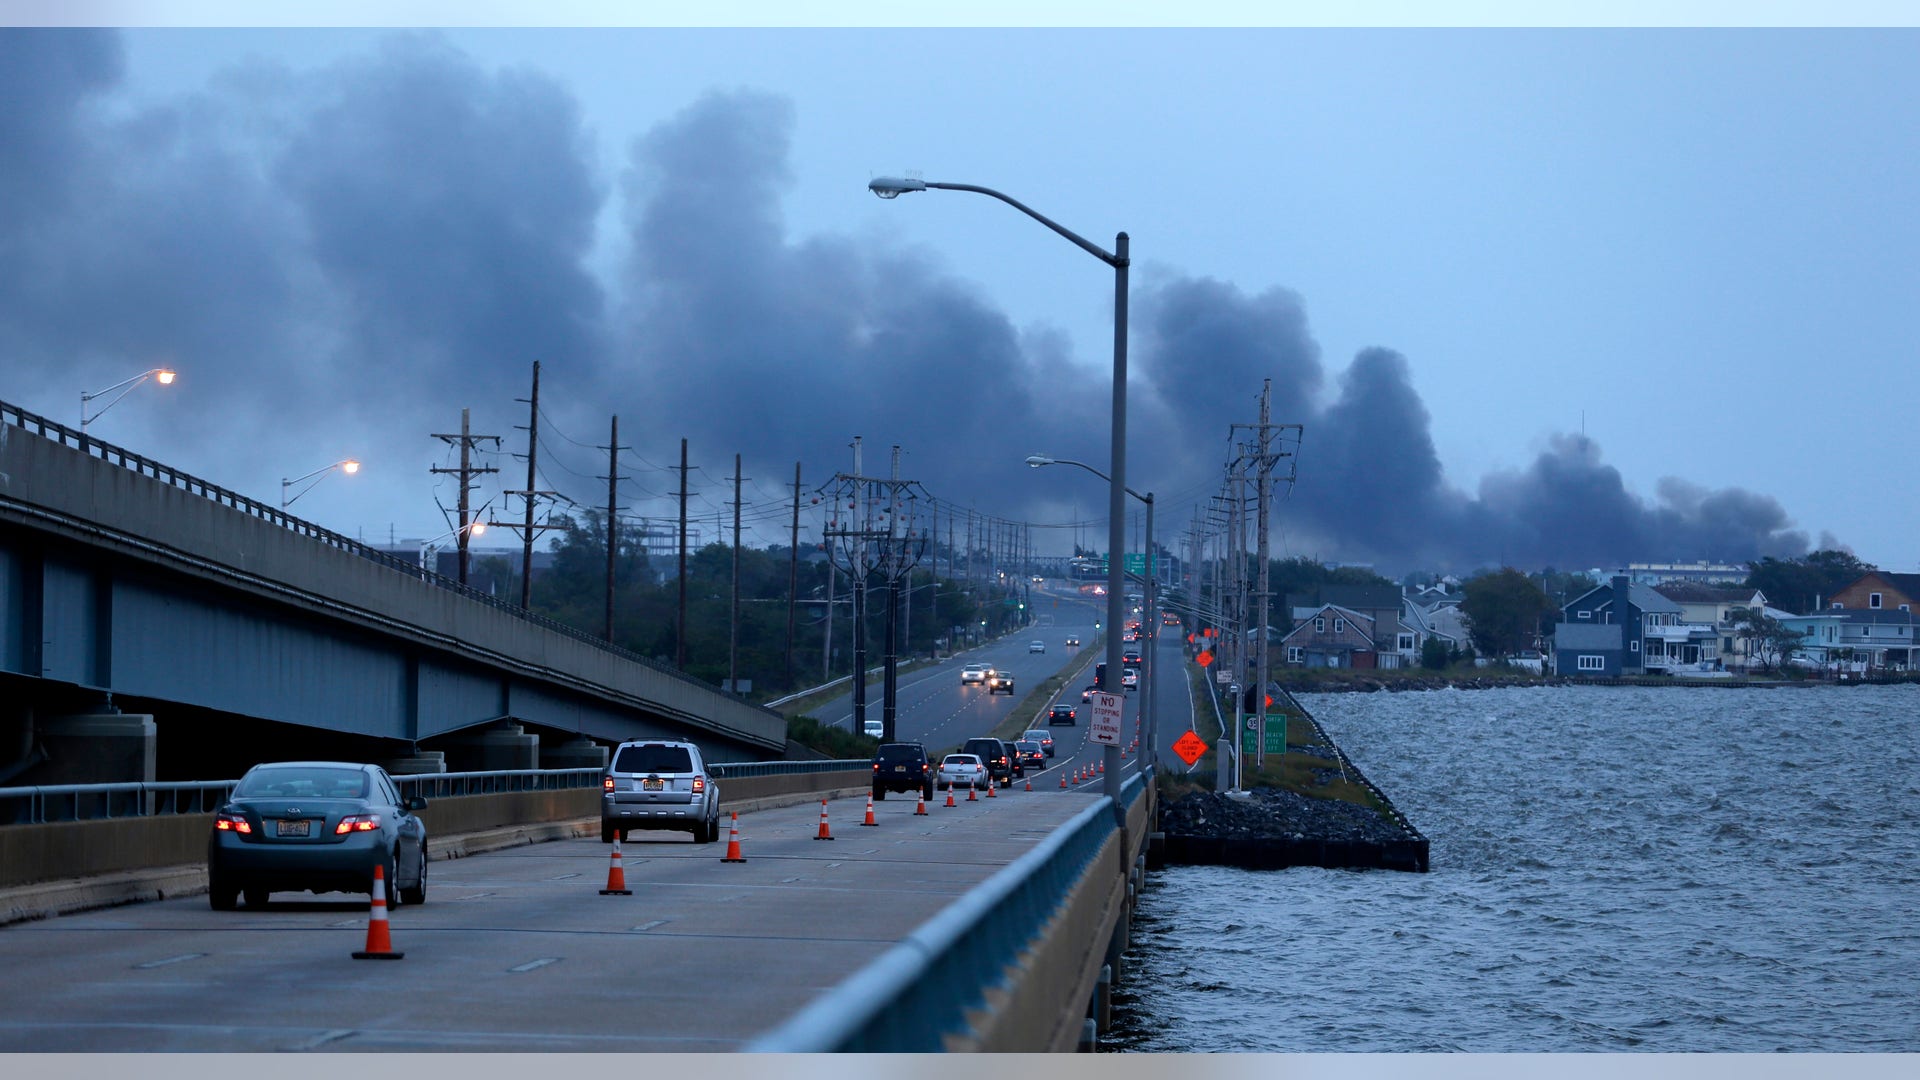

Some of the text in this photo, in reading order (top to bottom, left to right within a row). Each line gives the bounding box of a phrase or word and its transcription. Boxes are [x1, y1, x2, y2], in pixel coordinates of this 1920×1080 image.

[1101, 696, 1115, 707] NO
[1094, 708, 1119, 717] STOPPING
[1093, 724, 1119, 733] STANDING
